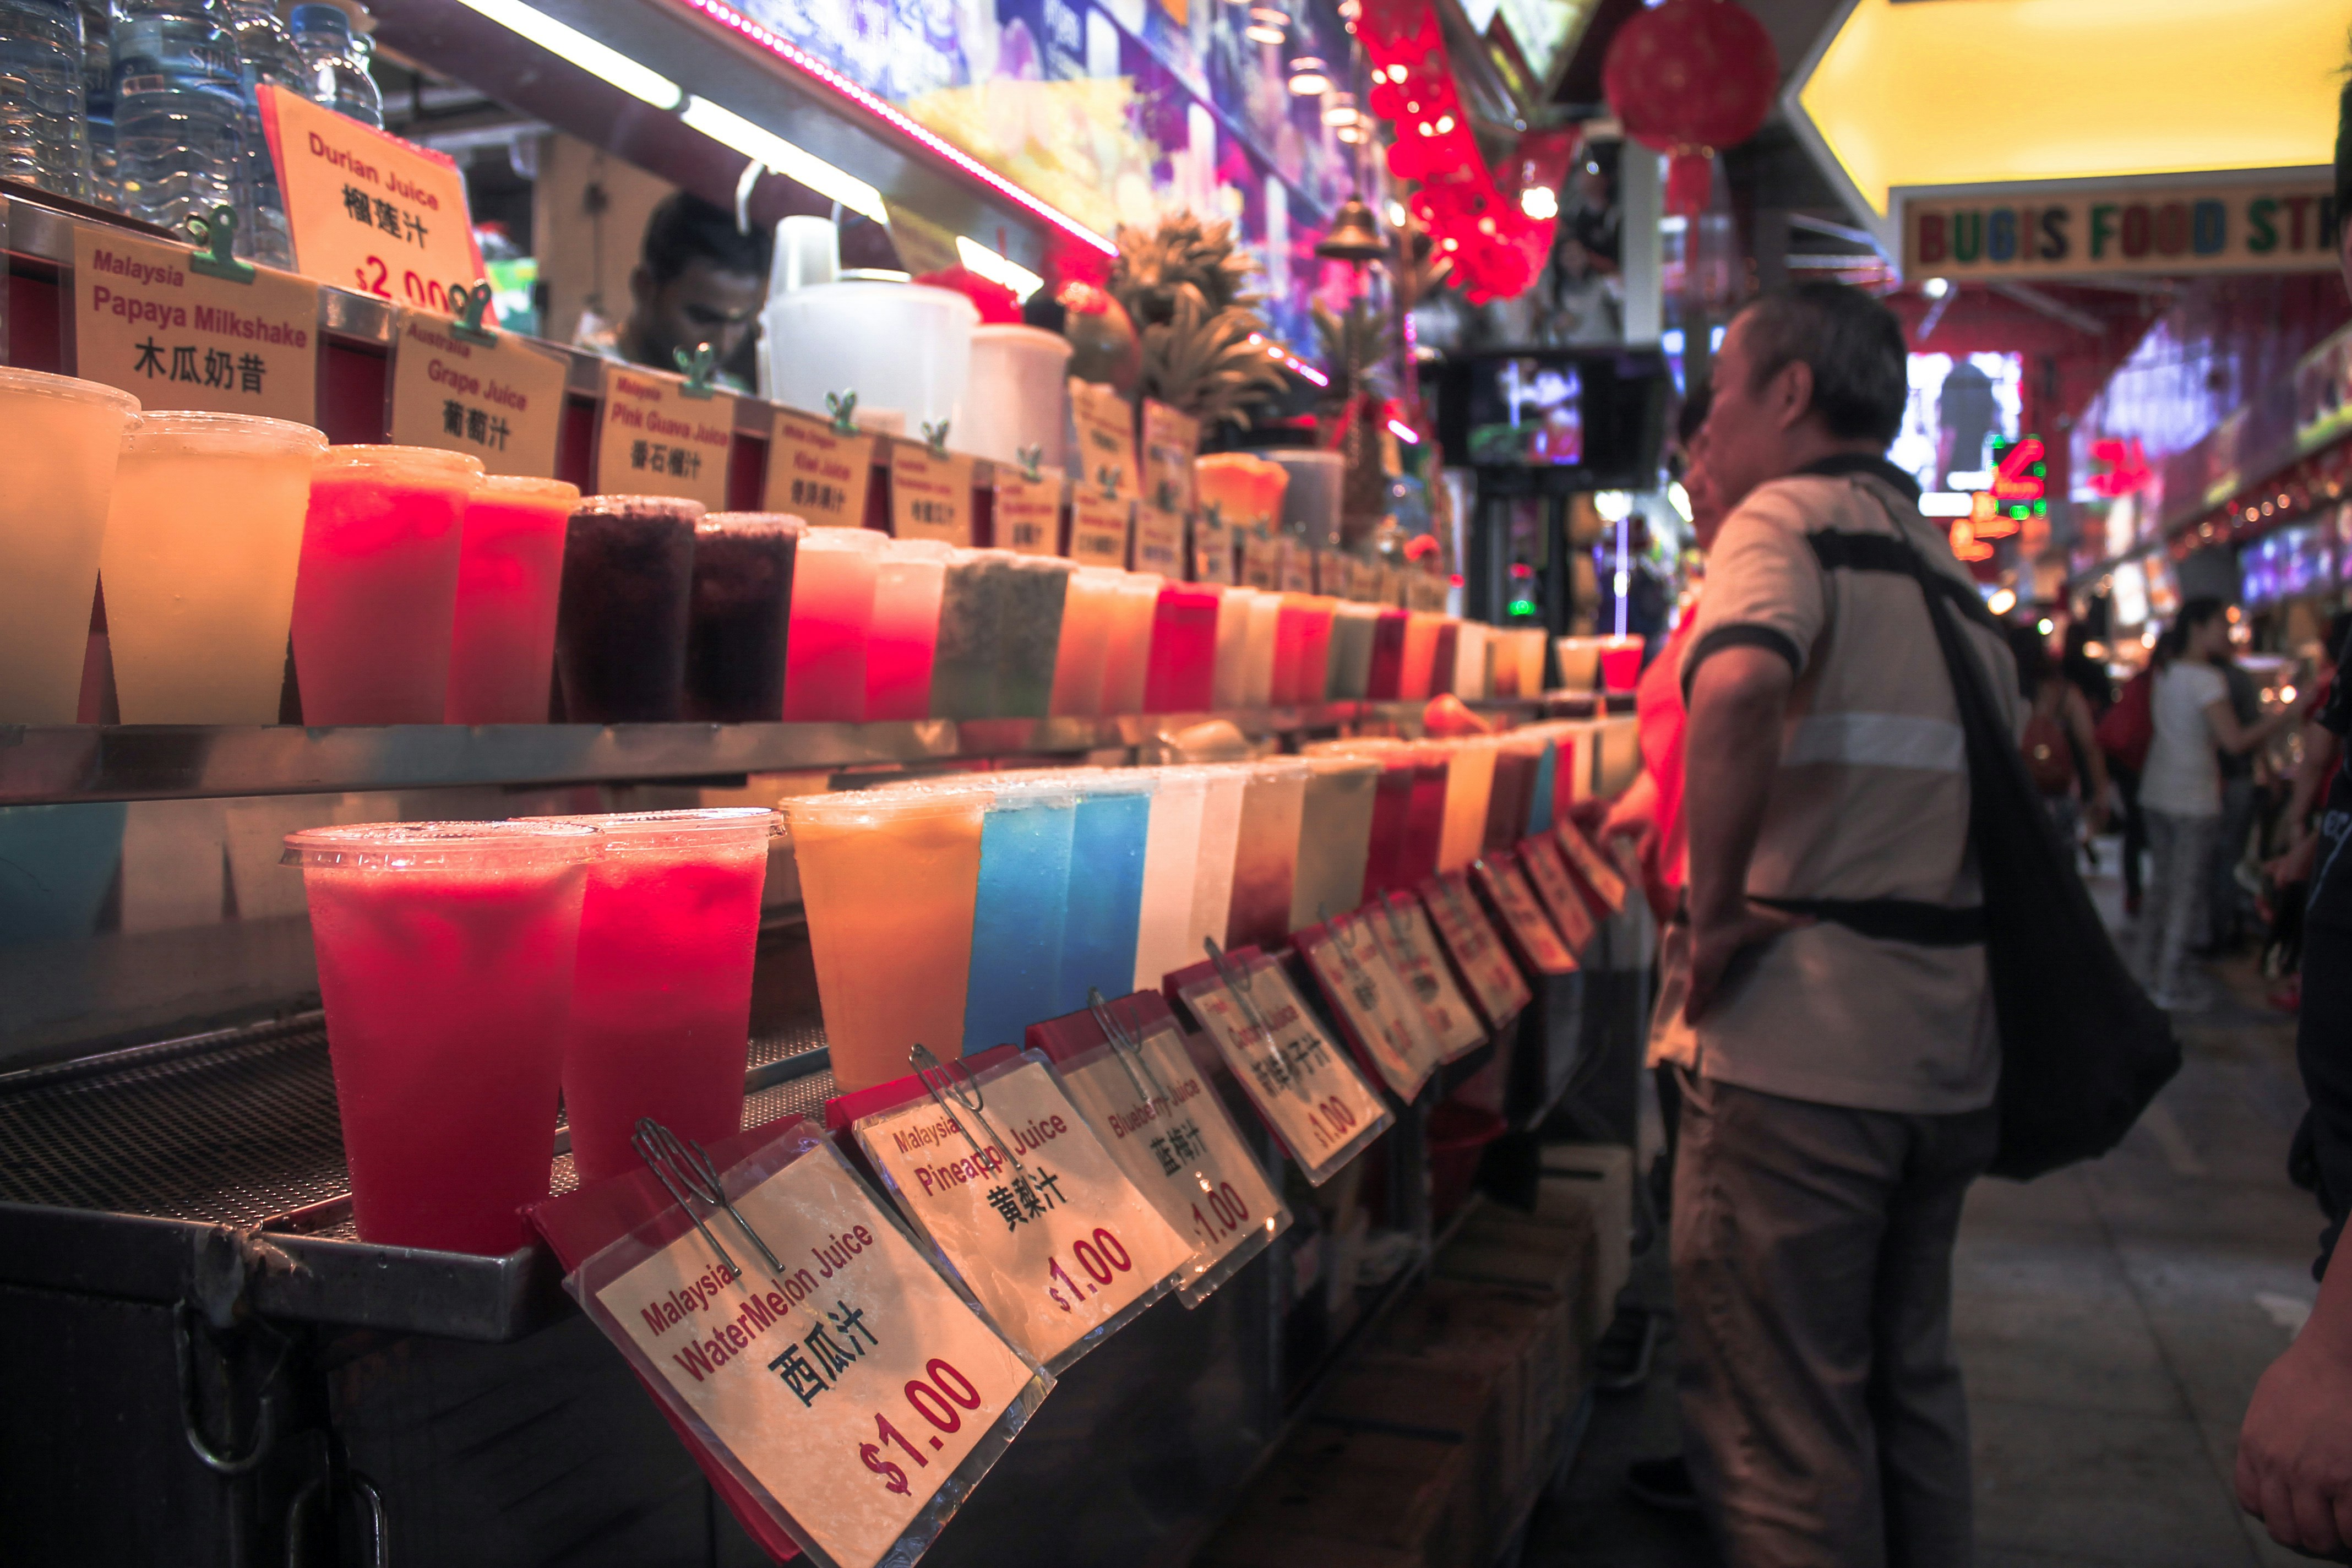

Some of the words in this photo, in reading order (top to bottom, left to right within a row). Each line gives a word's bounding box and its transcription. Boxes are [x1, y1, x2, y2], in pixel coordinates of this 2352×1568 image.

[309, 131, 379, 184] Durian
[385, 171, 439, 211] Juice
[1919, 206, 2068, 264] BUGIS
[2090, 199, 2227, 259] FOOD
[93, 249, 184, 287] Malaysia
[94, 285, 186, 331] Papaya
[195, 305, 308, 349] Milkshake
[134, 336, 267, 395] 木瓜奶昔
[428, 358, 480, 395] Grape
[483, 379, 527, 411] Juice
[443, 399, 511, 451] 葡萄汁
[694, 423, 728, 447] Juice
[892, 1116, 961, 1154] Malaysia
[1010, 1114, 1067, 1156] Juice
[1108, 1097, 1172, 1139] Blueberry
[1167, 1078, 1200, 1106] Juice
[986, 1167, 1067, 1232] 黄梨汁
[1191, 1182, 1249, 1244] 1.00
[640, 1264, 736, 1336] Malaysia
[1048, 1228, 1132, 1314] $1.00
[673, 1267, 819, 1382] WaterMelon
[812, 1224, 873, 1278] Juice
[767, 1300, 879, 1407] 西瓜汁
[859, 1358, 981, 1497] $1.00
